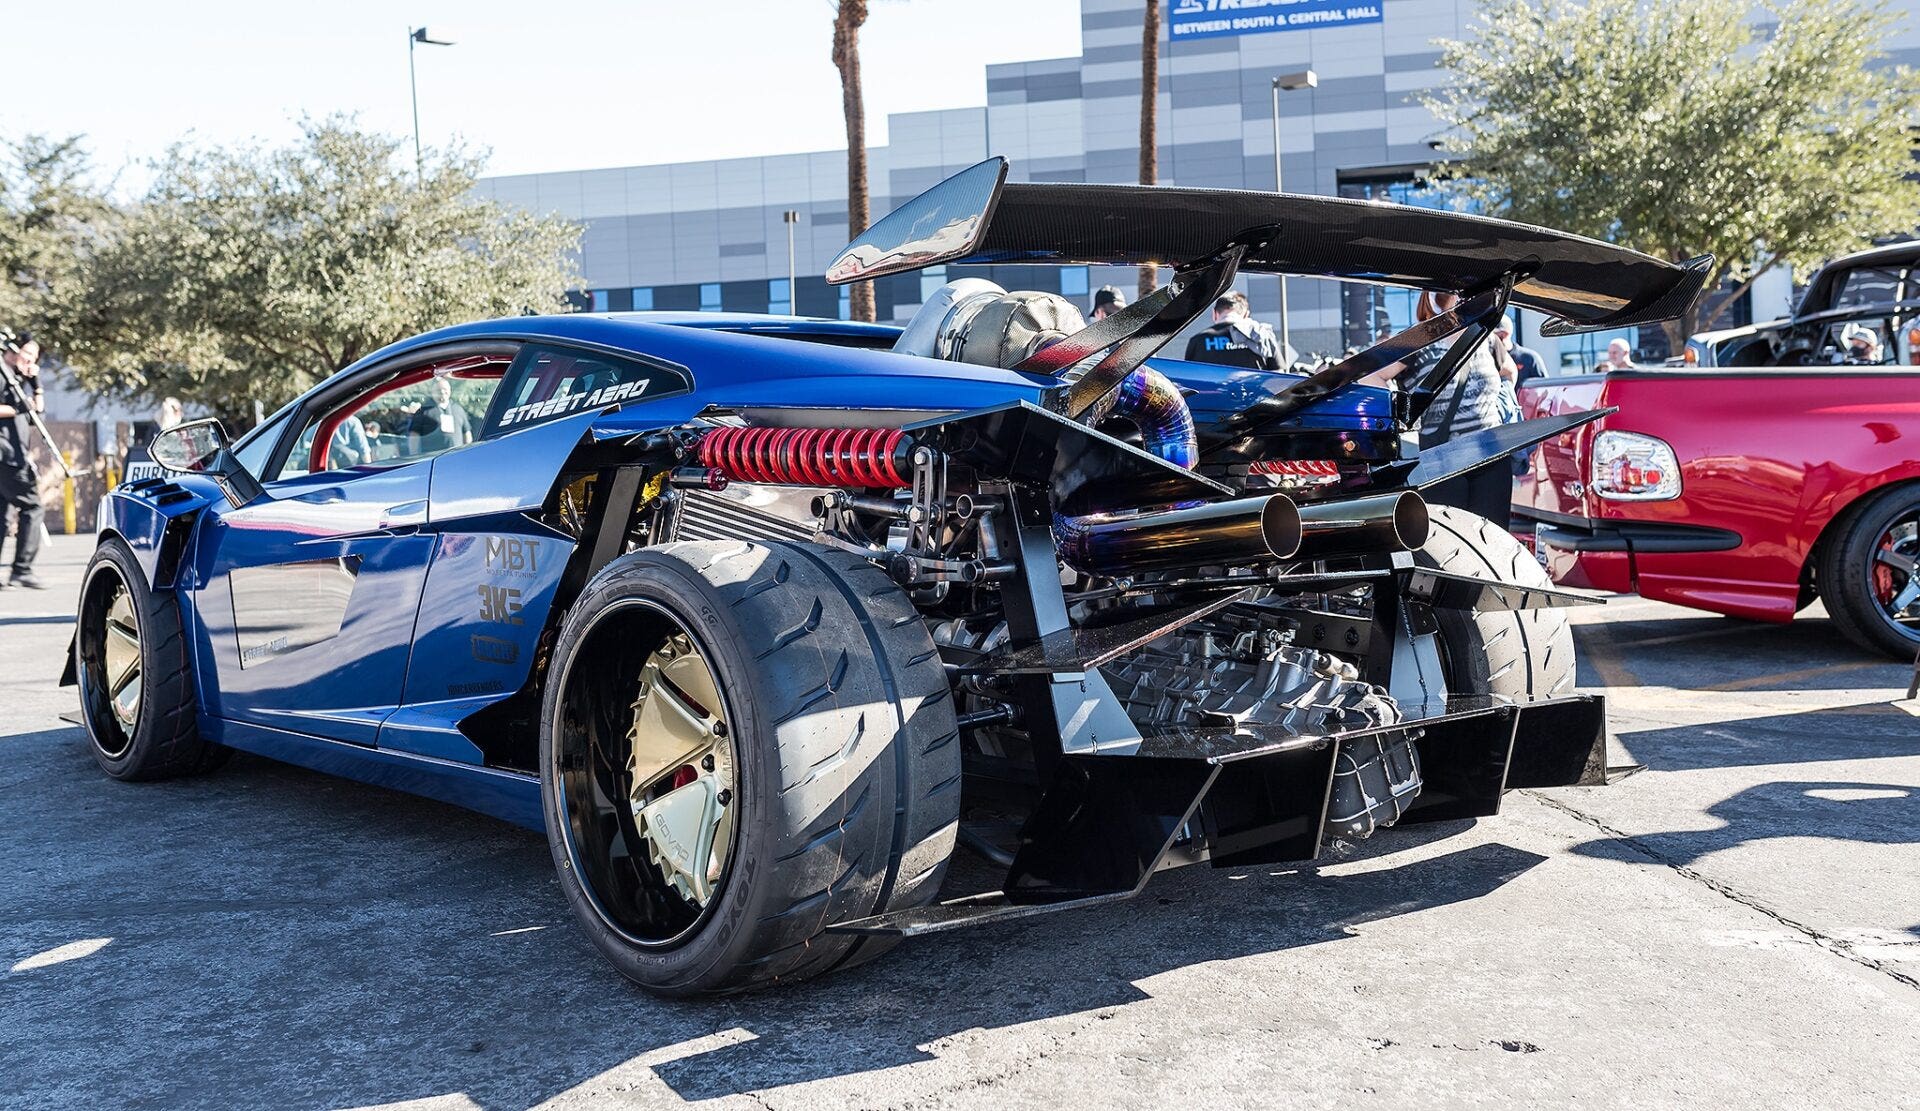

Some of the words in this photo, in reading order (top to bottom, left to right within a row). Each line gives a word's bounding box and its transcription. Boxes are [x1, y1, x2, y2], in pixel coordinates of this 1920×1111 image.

[1173, 20, 1231, 35] BETWEEN
[1233, 16, 1275, 29] SOUTH
[1276, 15, 1287, 26] &
[1288, 10, 1345, 25] CENTRAL
[1346, 6, 1380, 20] HALL
[498, 391, 589, 427] STREET
[583, 378, 650, 408] AERO
[486, 537, 540, 571] MBT
[478, 584, 524, 625] 3KE
[716, 857, 757, 949] TOYO
